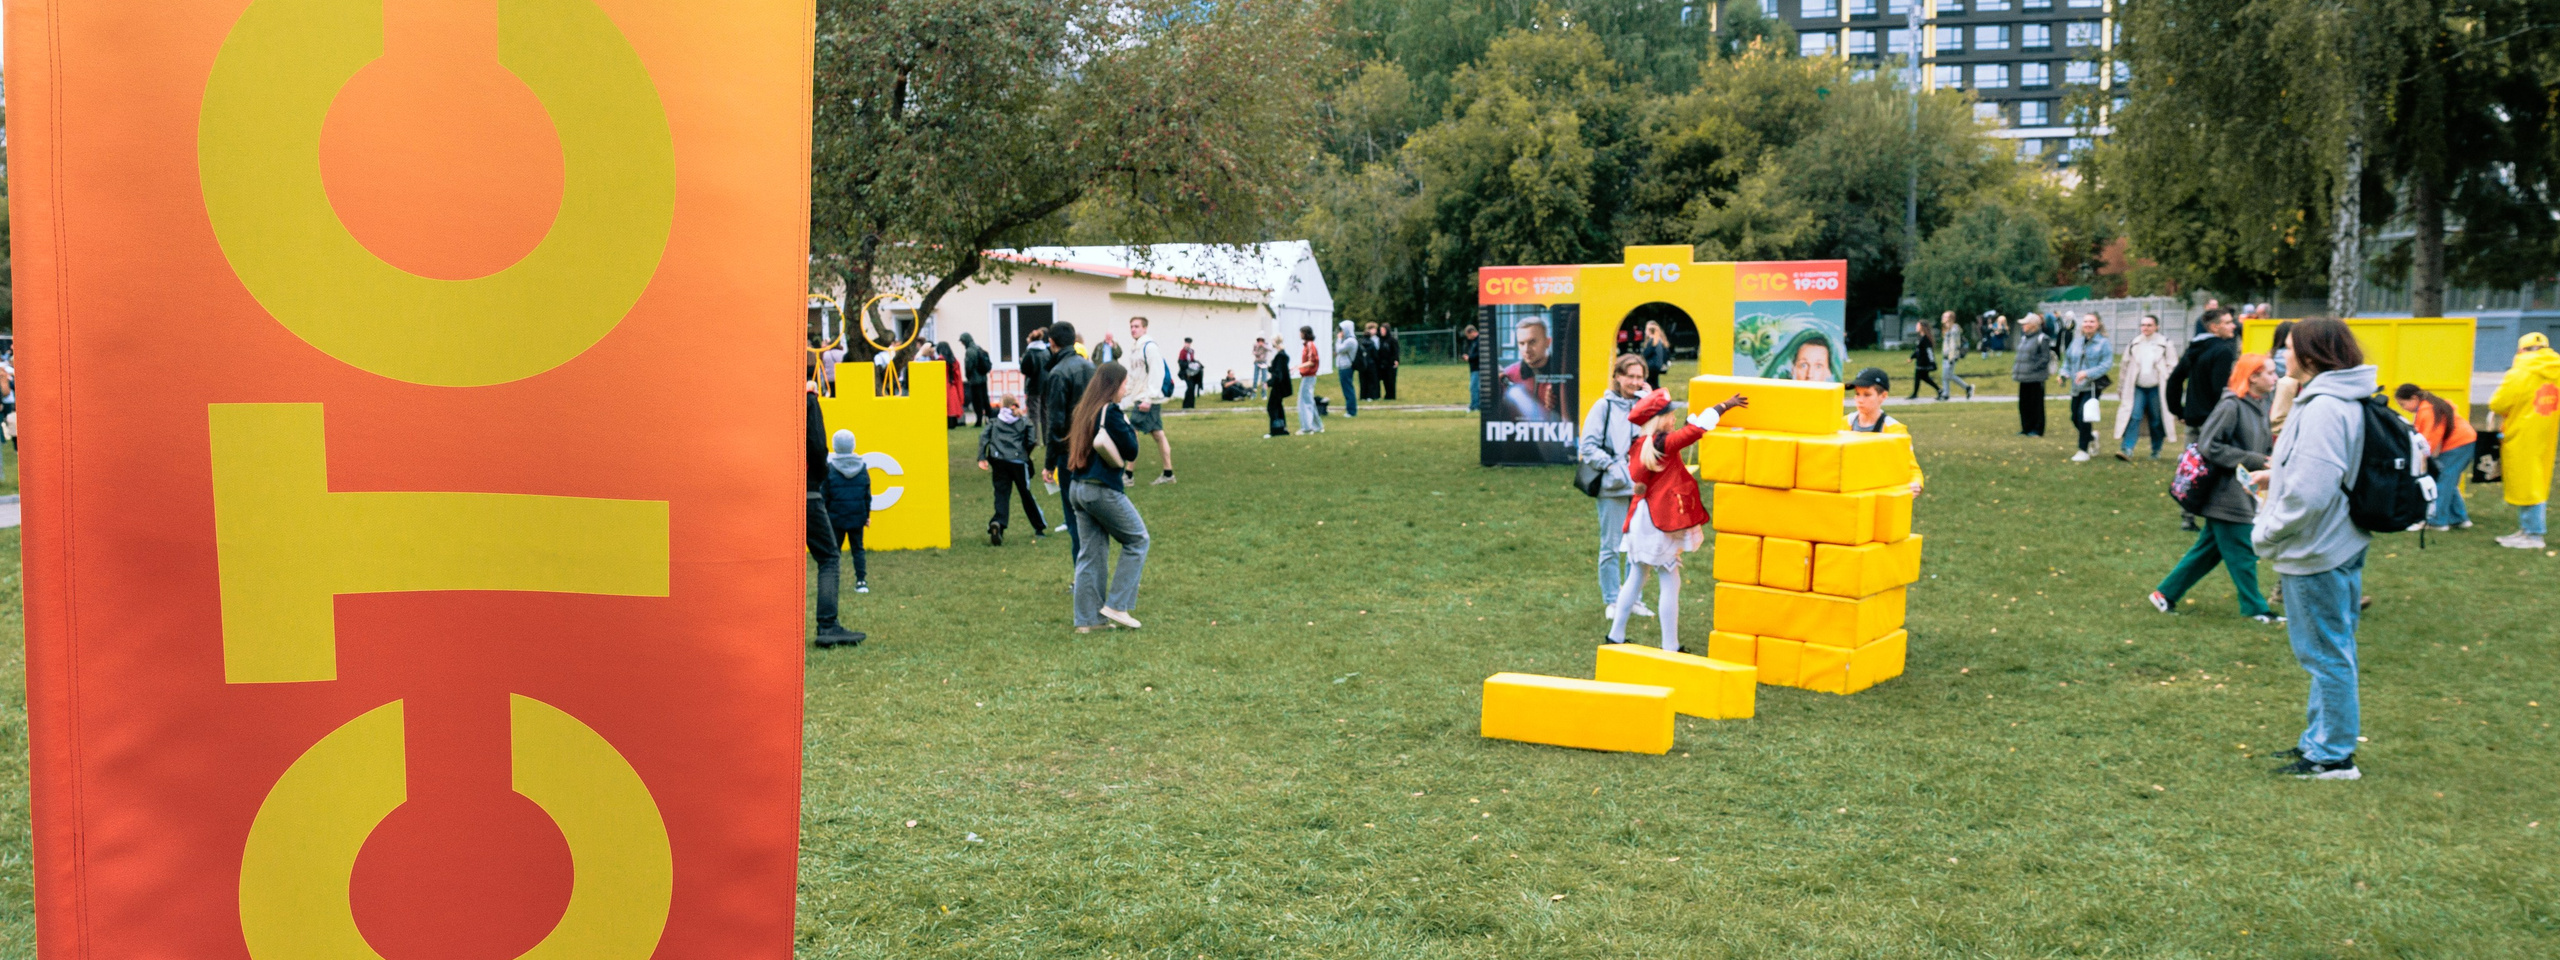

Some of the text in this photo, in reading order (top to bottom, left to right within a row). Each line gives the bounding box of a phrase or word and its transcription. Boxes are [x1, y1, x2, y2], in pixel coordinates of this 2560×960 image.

[1632, 263, 1681, 283] СТС
[1741, 273, 1788, 291] СТС
[1485, 277, 1529, 295] СТС
[1533, 282, 1574, 295] 17:00
[1793, 278, 1839, 291] 19:00
[1486, 421, 1574, 442] ПРЯТКИ
[198, 0, 676, 960] СТС
